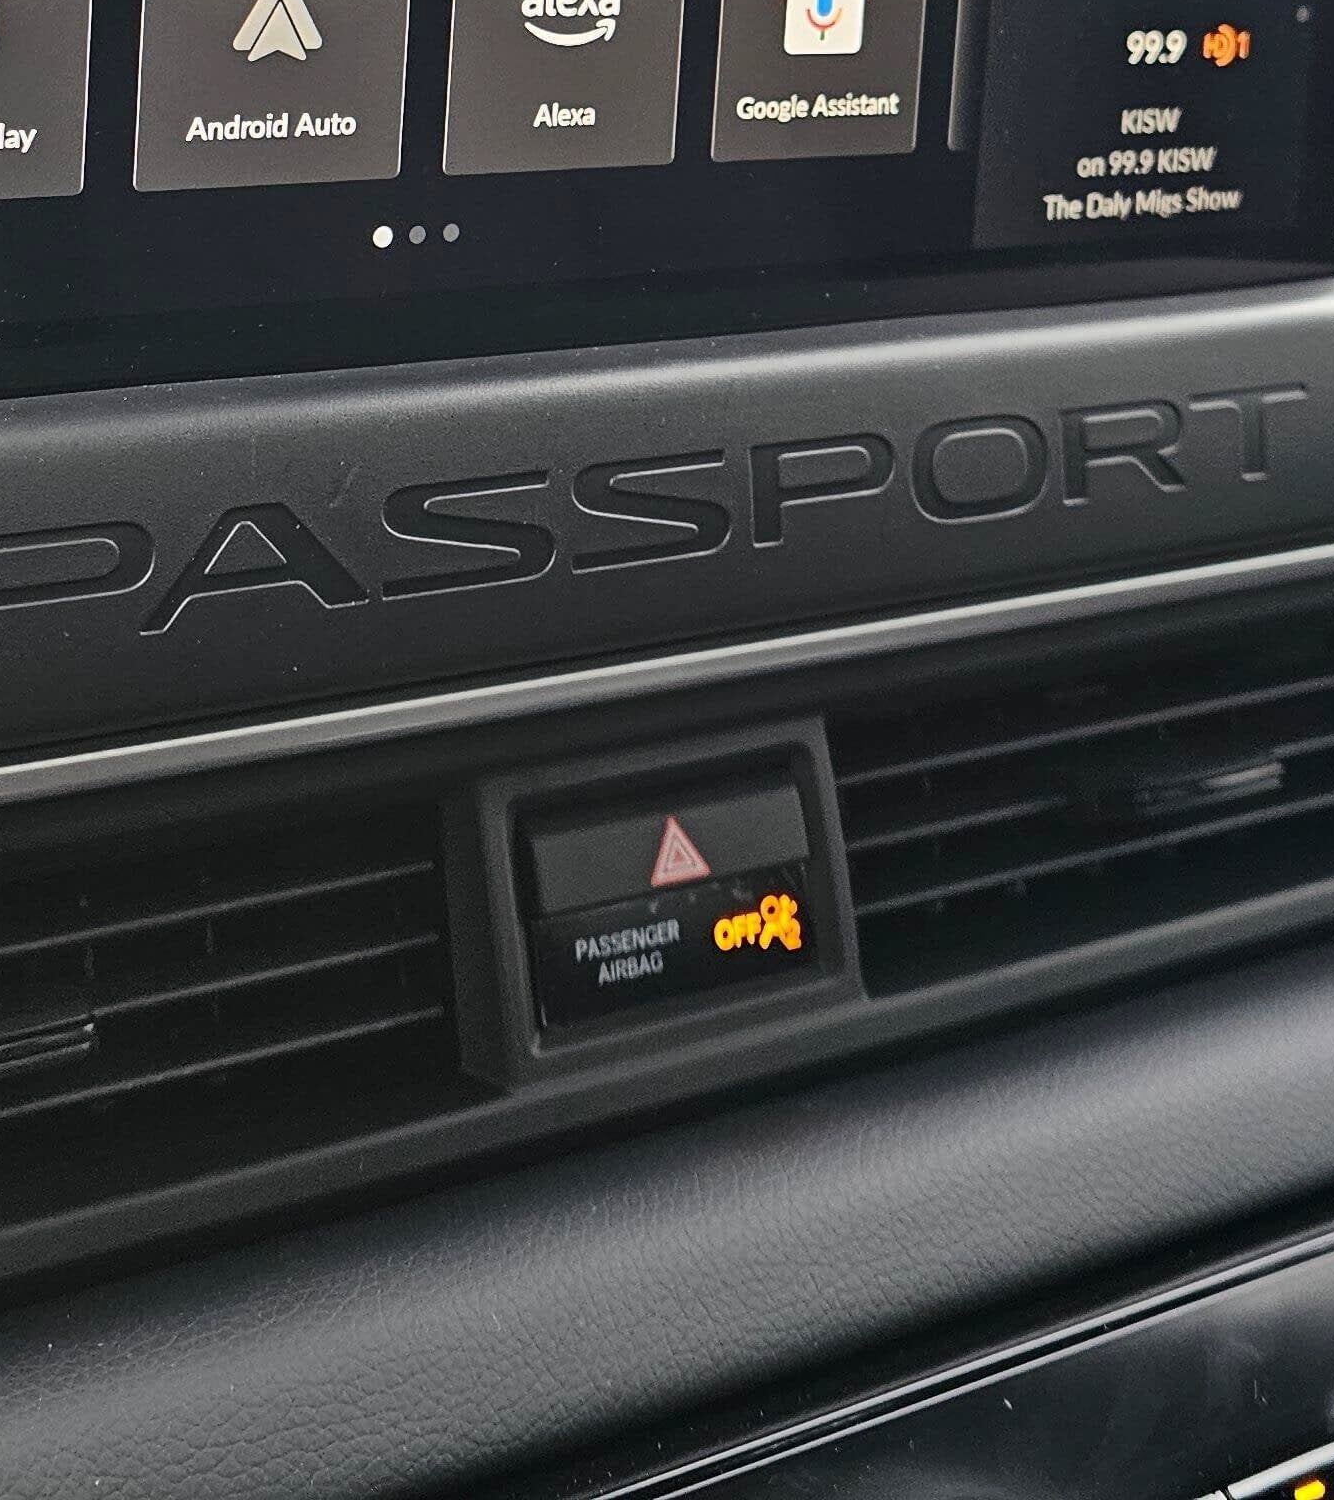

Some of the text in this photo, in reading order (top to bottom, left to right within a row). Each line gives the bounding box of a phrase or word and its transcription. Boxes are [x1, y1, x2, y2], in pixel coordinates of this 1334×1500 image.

[1126, 29, 1188, 65] 99.9
[533, 102, 596, 130] Alexa
[736, 91, 900, 122] Google Assistant
[1121, 107, 1182, 135] KISW
[185, 111, 357, 143] Android Auto
[1077, 146, 1217, 178] on 99.9 KISW
[1043, 193, 1084, 221] The
[1185, 185, 1243, 213] Show
[575, 918, 680, 963] PASSENGER
[713, 911, 762, 951] OFF
[598, 950, 664, 986] AIRBAG
